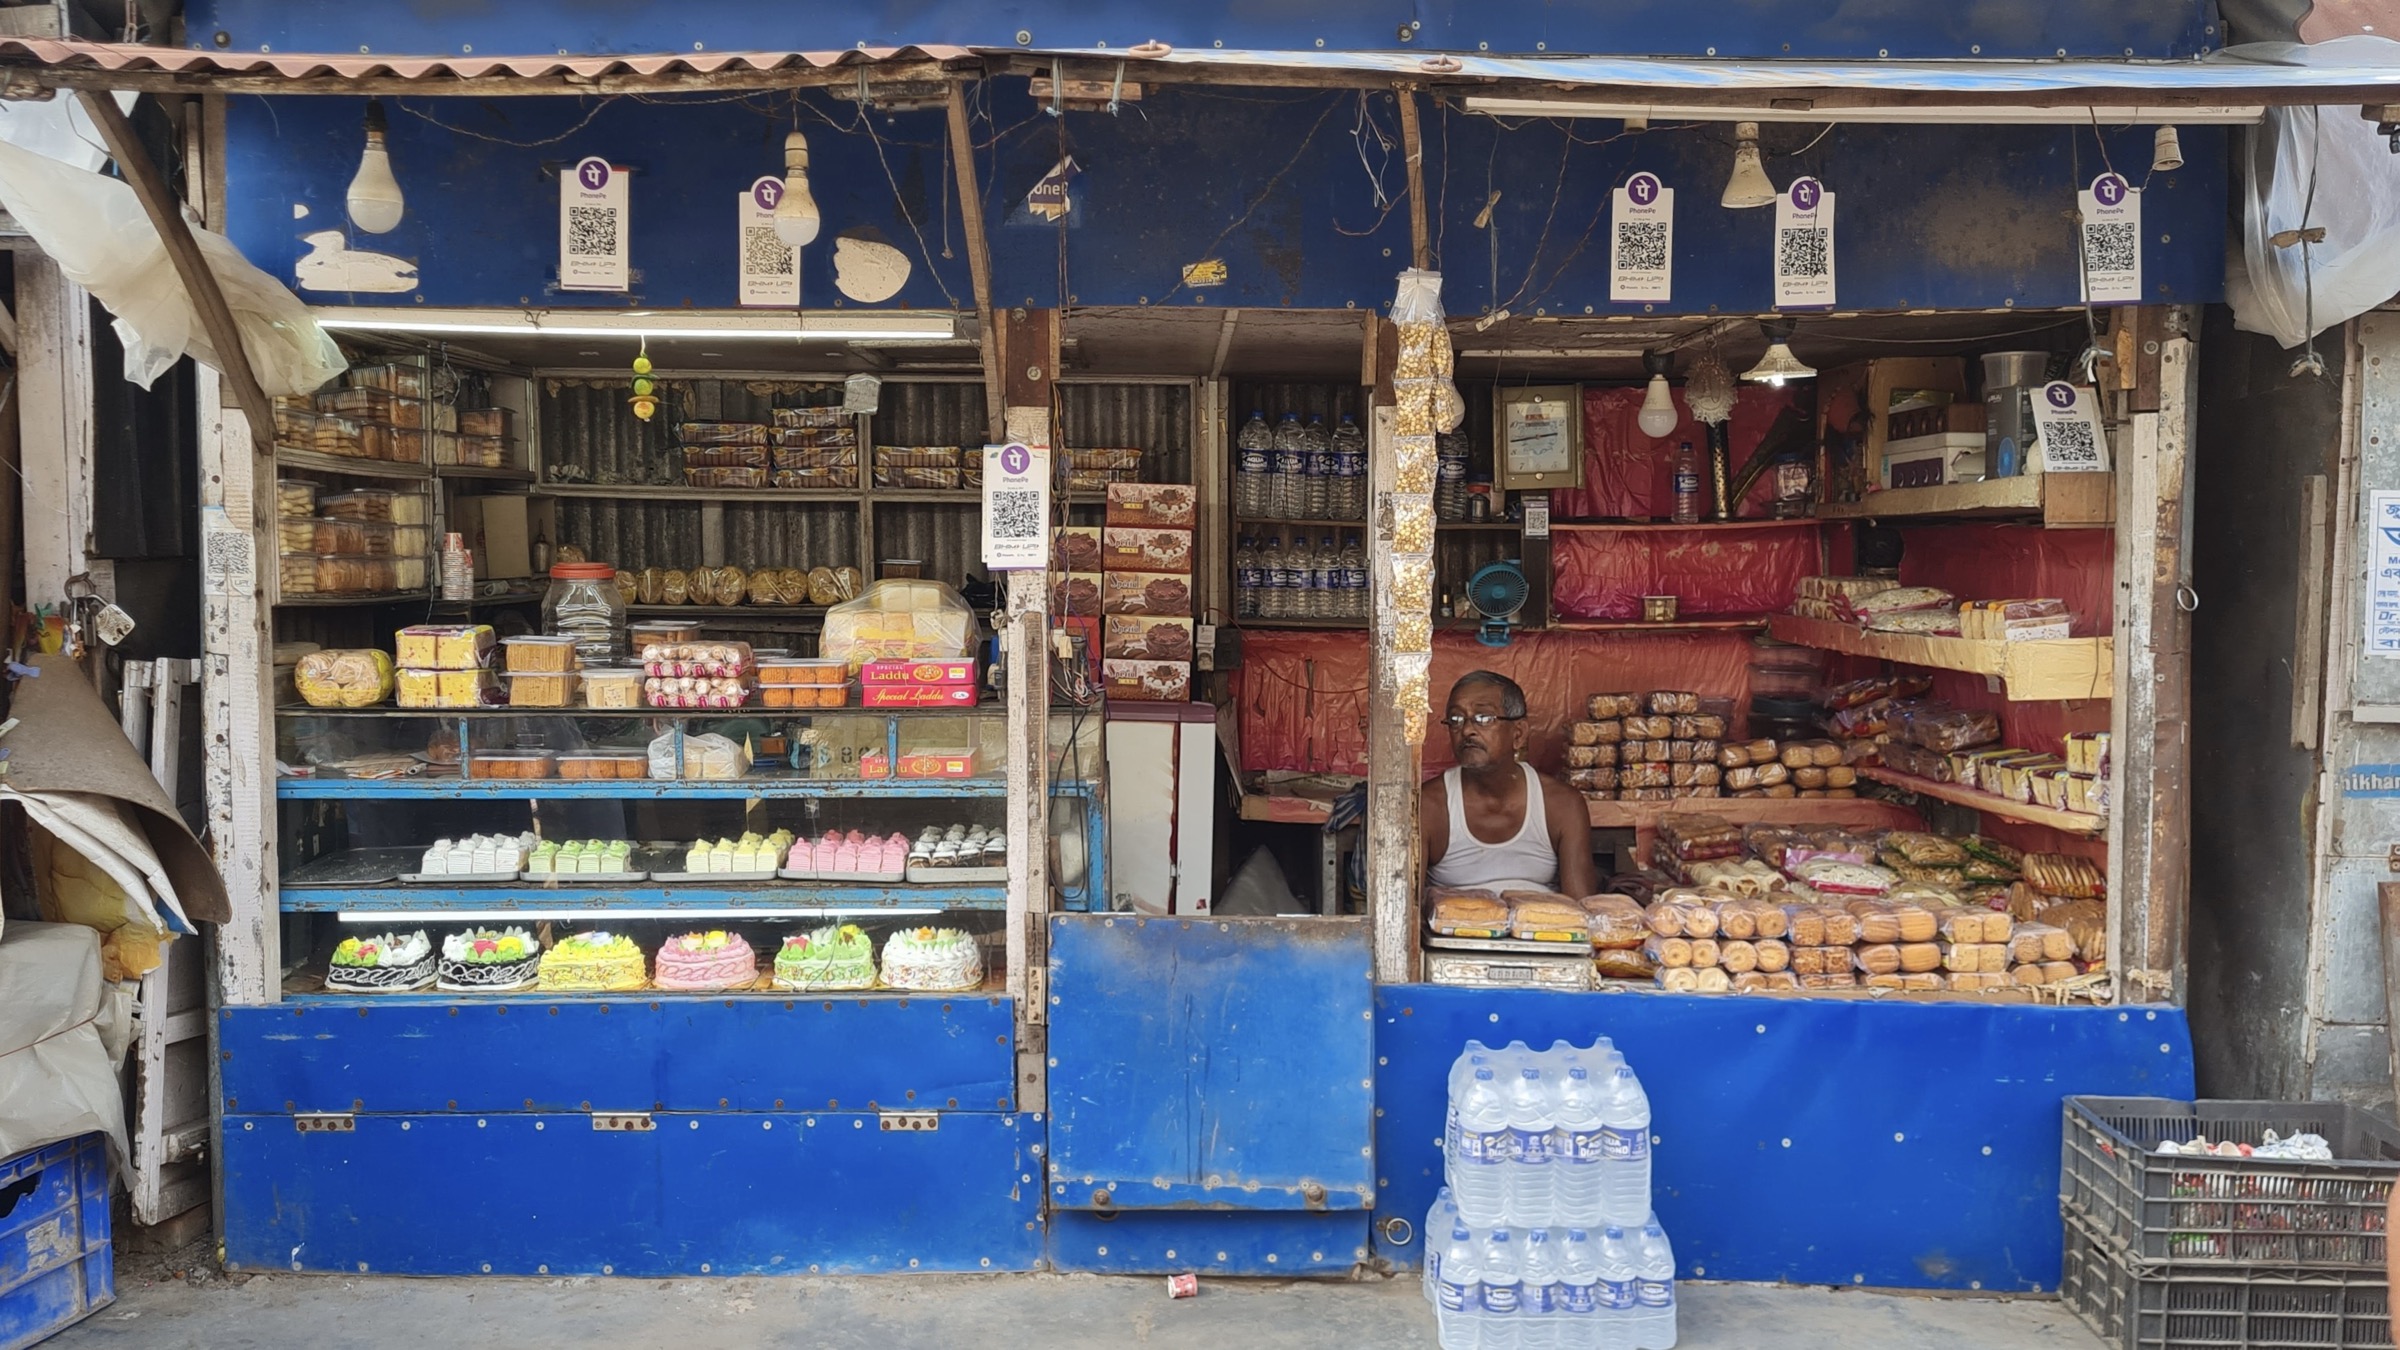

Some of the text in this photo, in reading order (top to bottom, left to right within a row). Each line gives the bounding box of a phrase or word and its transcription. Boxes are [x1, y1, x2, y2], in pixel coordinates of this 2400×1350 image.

[580, 192, 607, 200] PhonePe
[756, 211, 775, 219] Phone
[1629, 207, 1657, 215] PhonePe
[2096, 207, 2124, 215] PhonePe
[1002, 476, 1029, 484] PhonePe
[870, 671, 909, 680] Laddu
[872, 688, 910, 704] Special
[909, 687, 945, 701] Laddu
